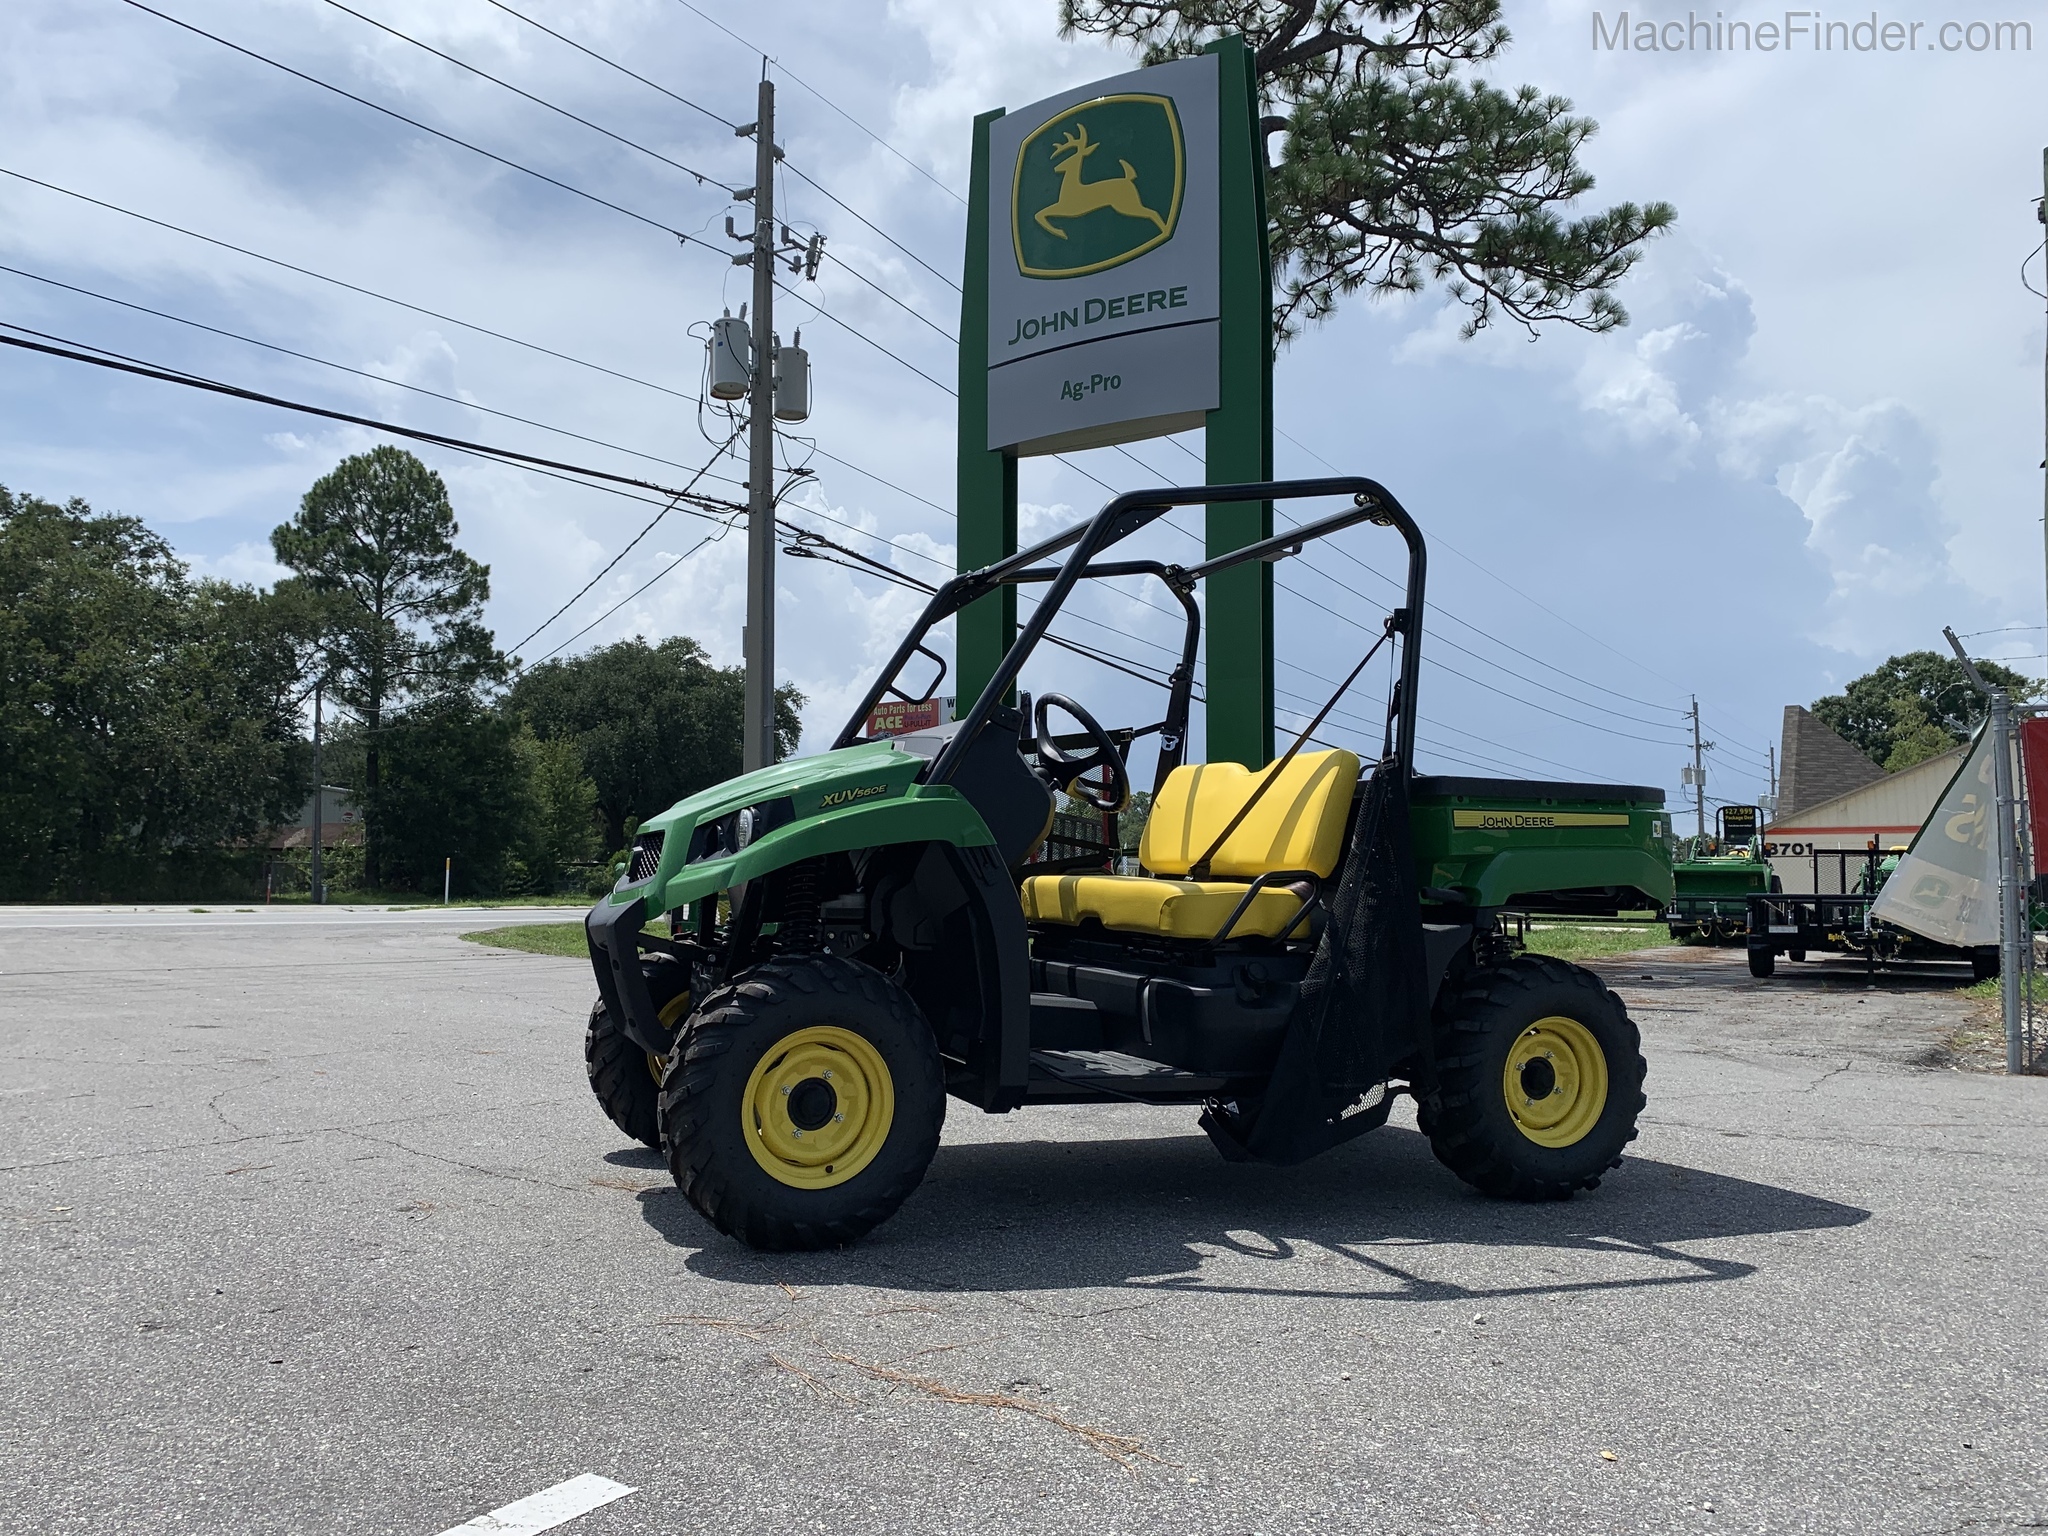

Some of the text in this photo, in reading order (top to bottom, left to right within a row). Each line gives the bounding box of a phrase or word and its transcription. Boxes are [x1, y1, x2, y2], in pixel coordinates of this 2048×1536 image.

[1008, 285, 1188, 346] JOHN DEERE
[1060, 374, 1122, 401] Ag-Pro
[873, 703, 932, 716] Auto Parts for Less
[874, 715, 903, 730] ACE
[820, 784, 887, 807] XUV560E
[1725, 808, 1753, 816] $27,999
[1480, 815, 1555, 827] JOHN DEERE
